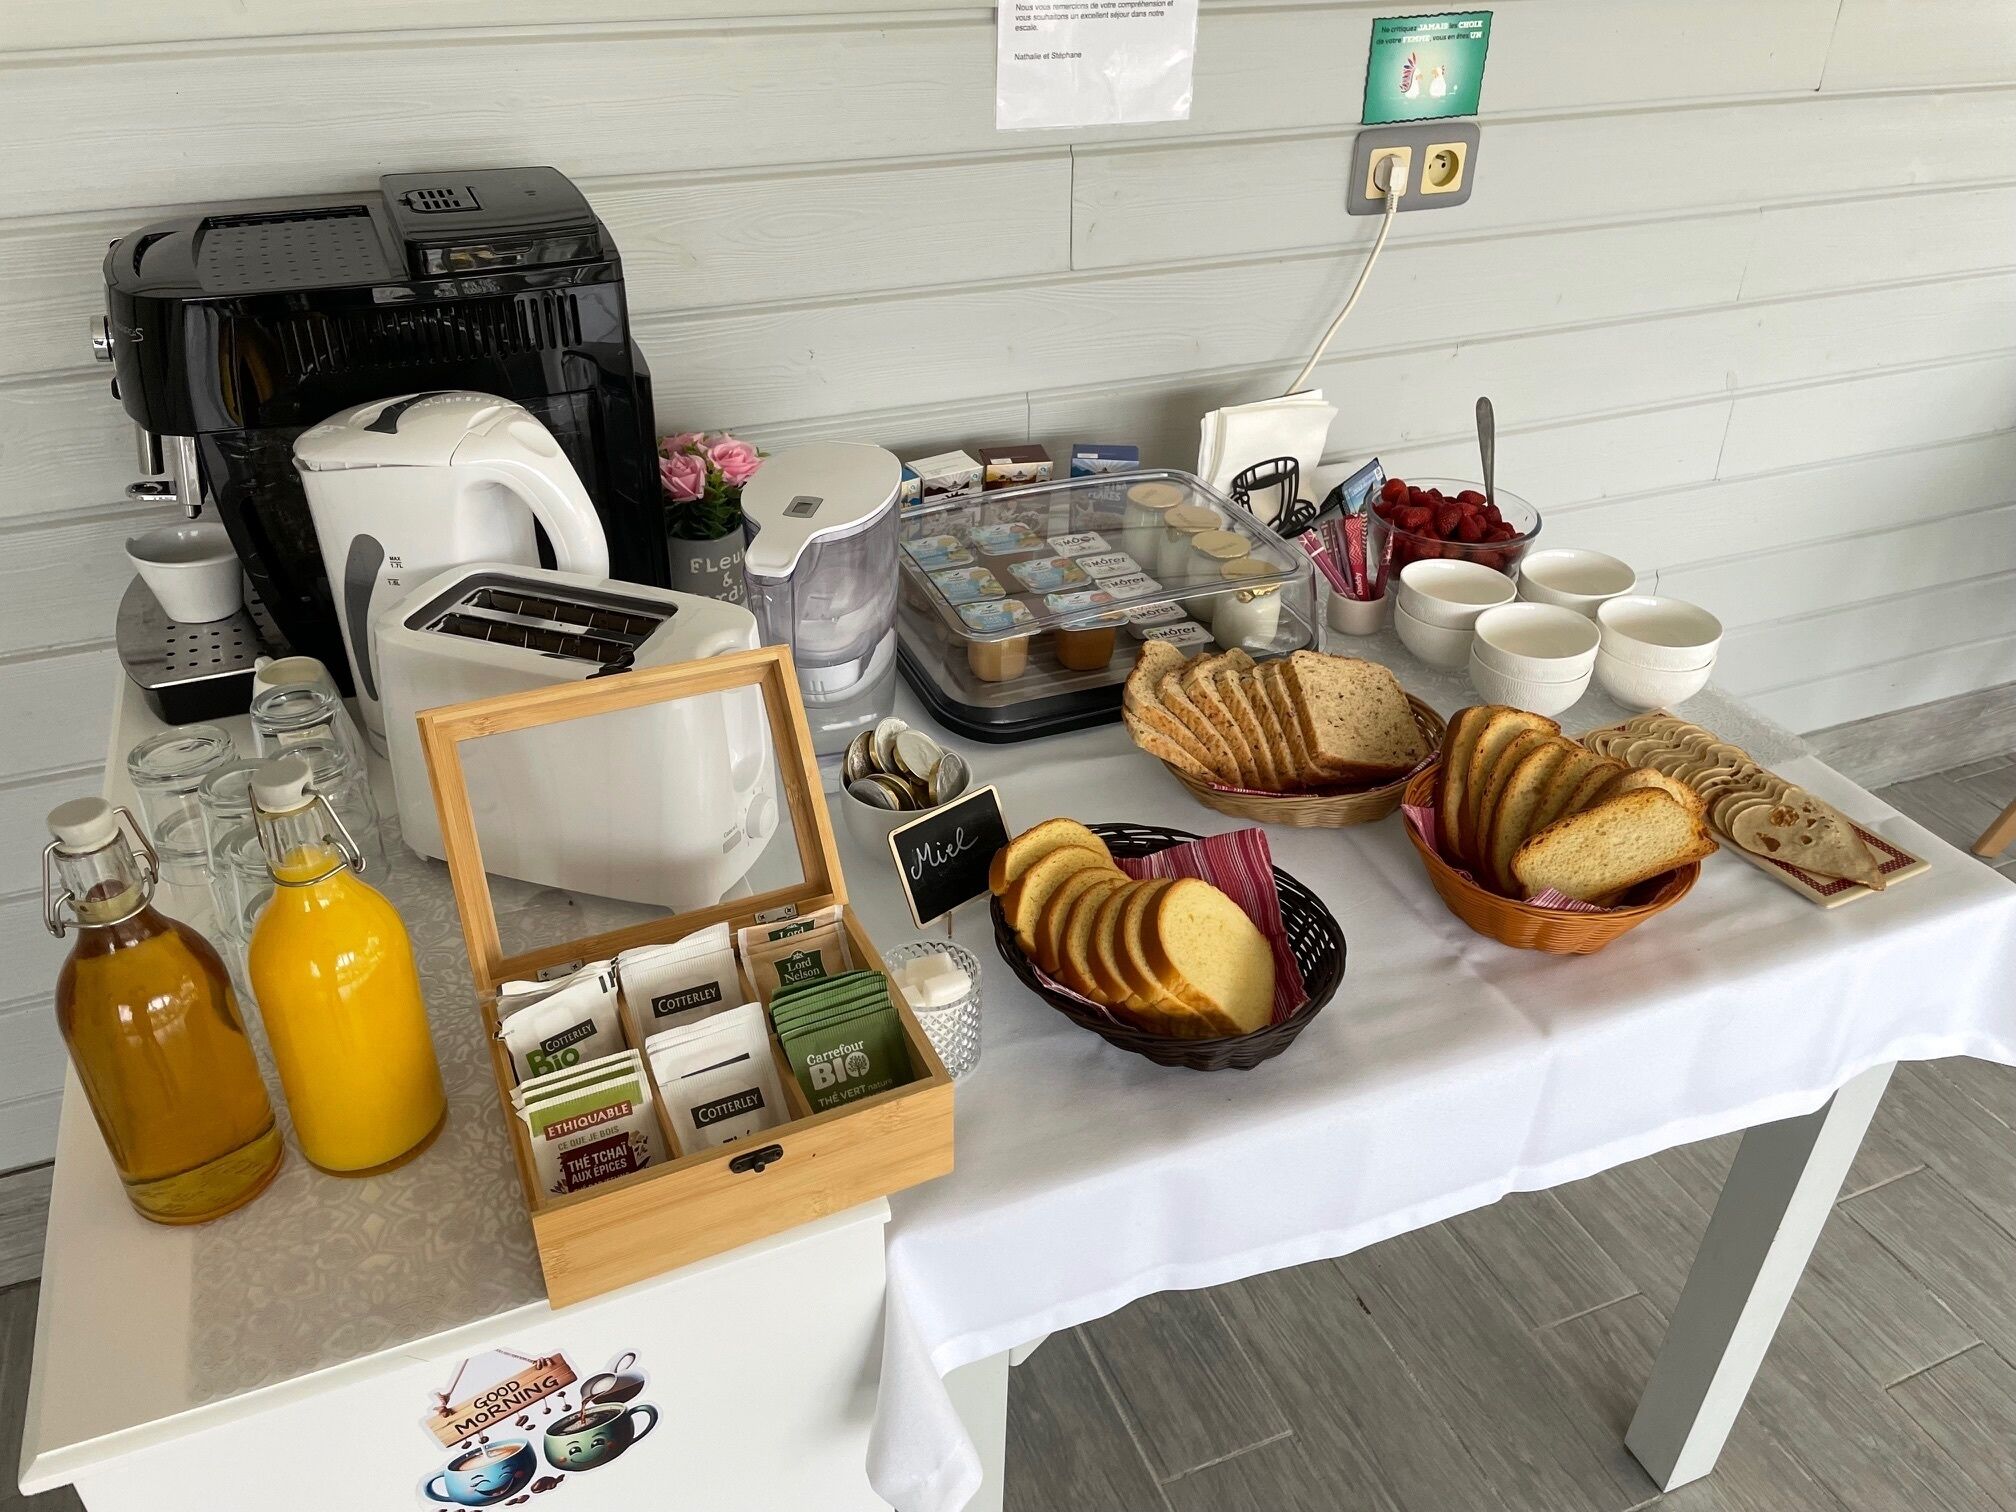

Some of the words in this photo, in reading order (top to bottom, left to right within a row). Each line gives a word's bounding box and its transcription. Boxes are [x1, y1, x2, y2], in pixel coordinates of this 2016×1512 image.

[1016, 3, 1033, 11] Nous
[1118, 0, 1166, 8] compréhension
[1033, 12, 1069, 20] souhaitons
[1110, 11, 1130, 19] séjour
[1391, 25, 1417, 33] critiquez
[1417, 22, 1449, 31] JAMAIS
[1458, 20, 1484, 29] CHOIX
[1469, 31, 1483, 39] UN
[1051, 51, 1082, 60] Stéphane
[723, 571, 733, 587] &
[910, 826, 979, 880] Miel
[784, 967, 820, 984] Nelson
[786, 957, 812, 972] Lord
[657, 986, 718, 1014] COTTERLEY
[544, 1023, 593, 1053] COTTERLEY
[526, 1047, 580, 1078] Bio
[806, 1040, 865, 1066] Carrefour
[808, 1051, 870, 1091] BIO
[697, 1092, 760, 1124] COTTERLEY
[818, 1090, 840, 1107] THÉ
[840, 1084, 867, 1100] VERT
[546, 1102, 630, 1138] ETHIQUABLE
[557, 1141, 569, 1152] CE
[569, 1136, 587, 1148] QUE
[588, 1131, 598, 1142] JE
[599, 1125, 620, 1138] BOIS
[567, 1152, 592, 1173] THÉ
[591, 1142, 628, 1164] TCHAÏ
[571, 1168, 594, 1185] AUX
[593, 1157, 628, 1178] ÉPICES
[454, 1374, 559, 1436] MORNING
[473, 1380, 521, 1410] GOOD
